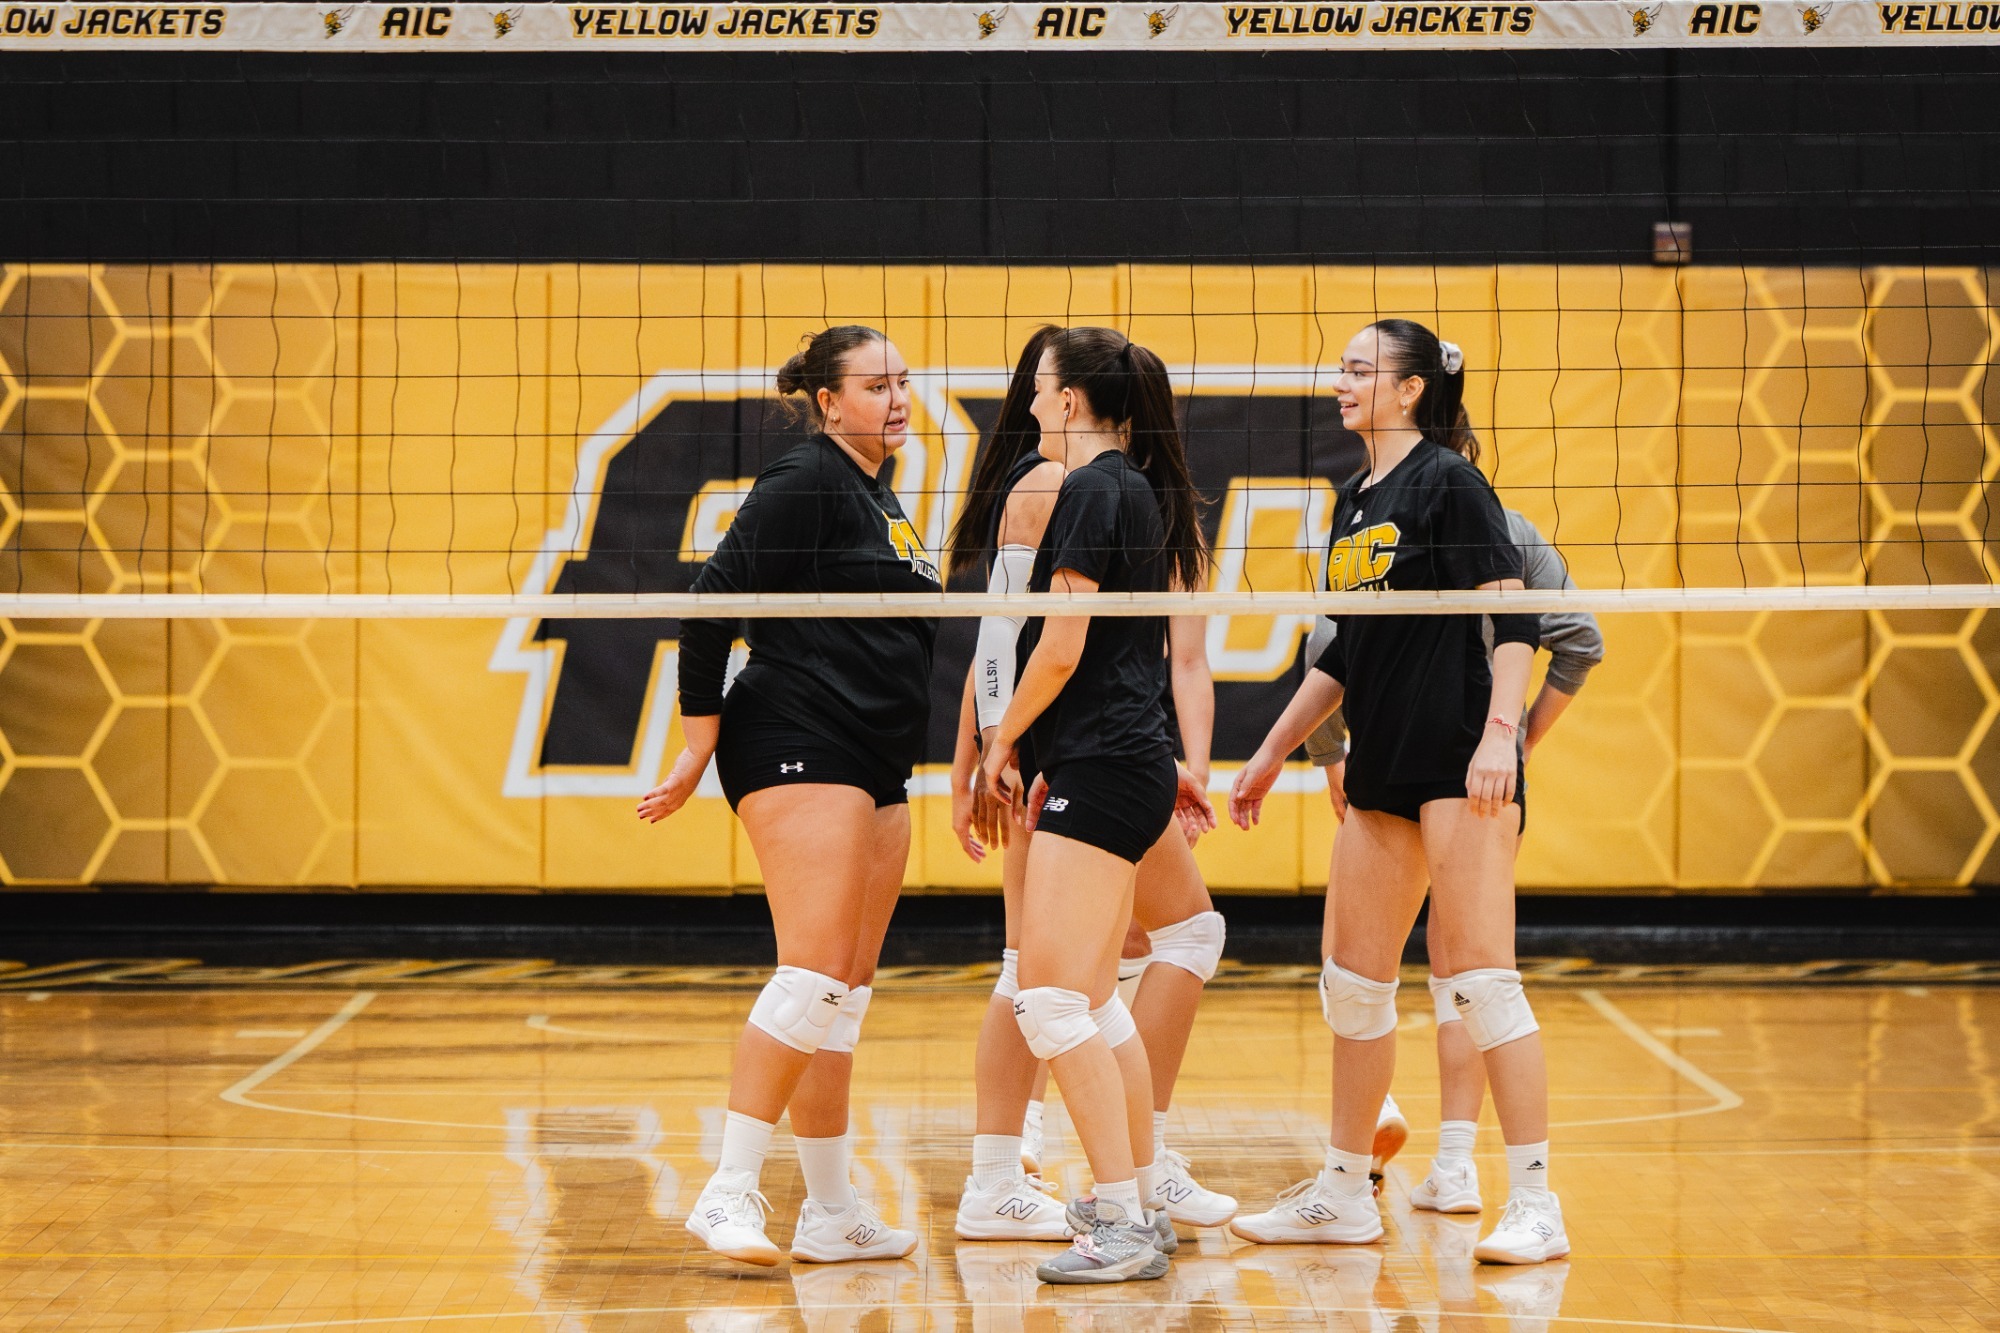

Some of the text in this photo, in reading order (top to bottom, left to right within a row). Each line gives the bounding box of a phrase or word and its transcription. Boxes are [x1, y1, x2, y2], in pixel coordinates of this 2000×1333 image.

[0, 7, 226, 37] OW JACKETS
[381, 7, 452, 37] AIC
[571, 8, 881, 37] YELLOW JACKETS
[1036, 7, 1106, 38] AIC
[1225, 6, 1535, 35] YELLOW JACKETS
[1690, 4, 1761, 34] AIC
[1328, 523, 1401, 592] AIC
[986, 658, 999, 698] ALLSIX
[705, 1207, 729, 1228] N
[995, 1197, 1039, 1221] N
[1296, 1203, 1338, 1225] N
[845, 1223, 876, 1246] N
[1530, 1221, 1554, 1242] N
